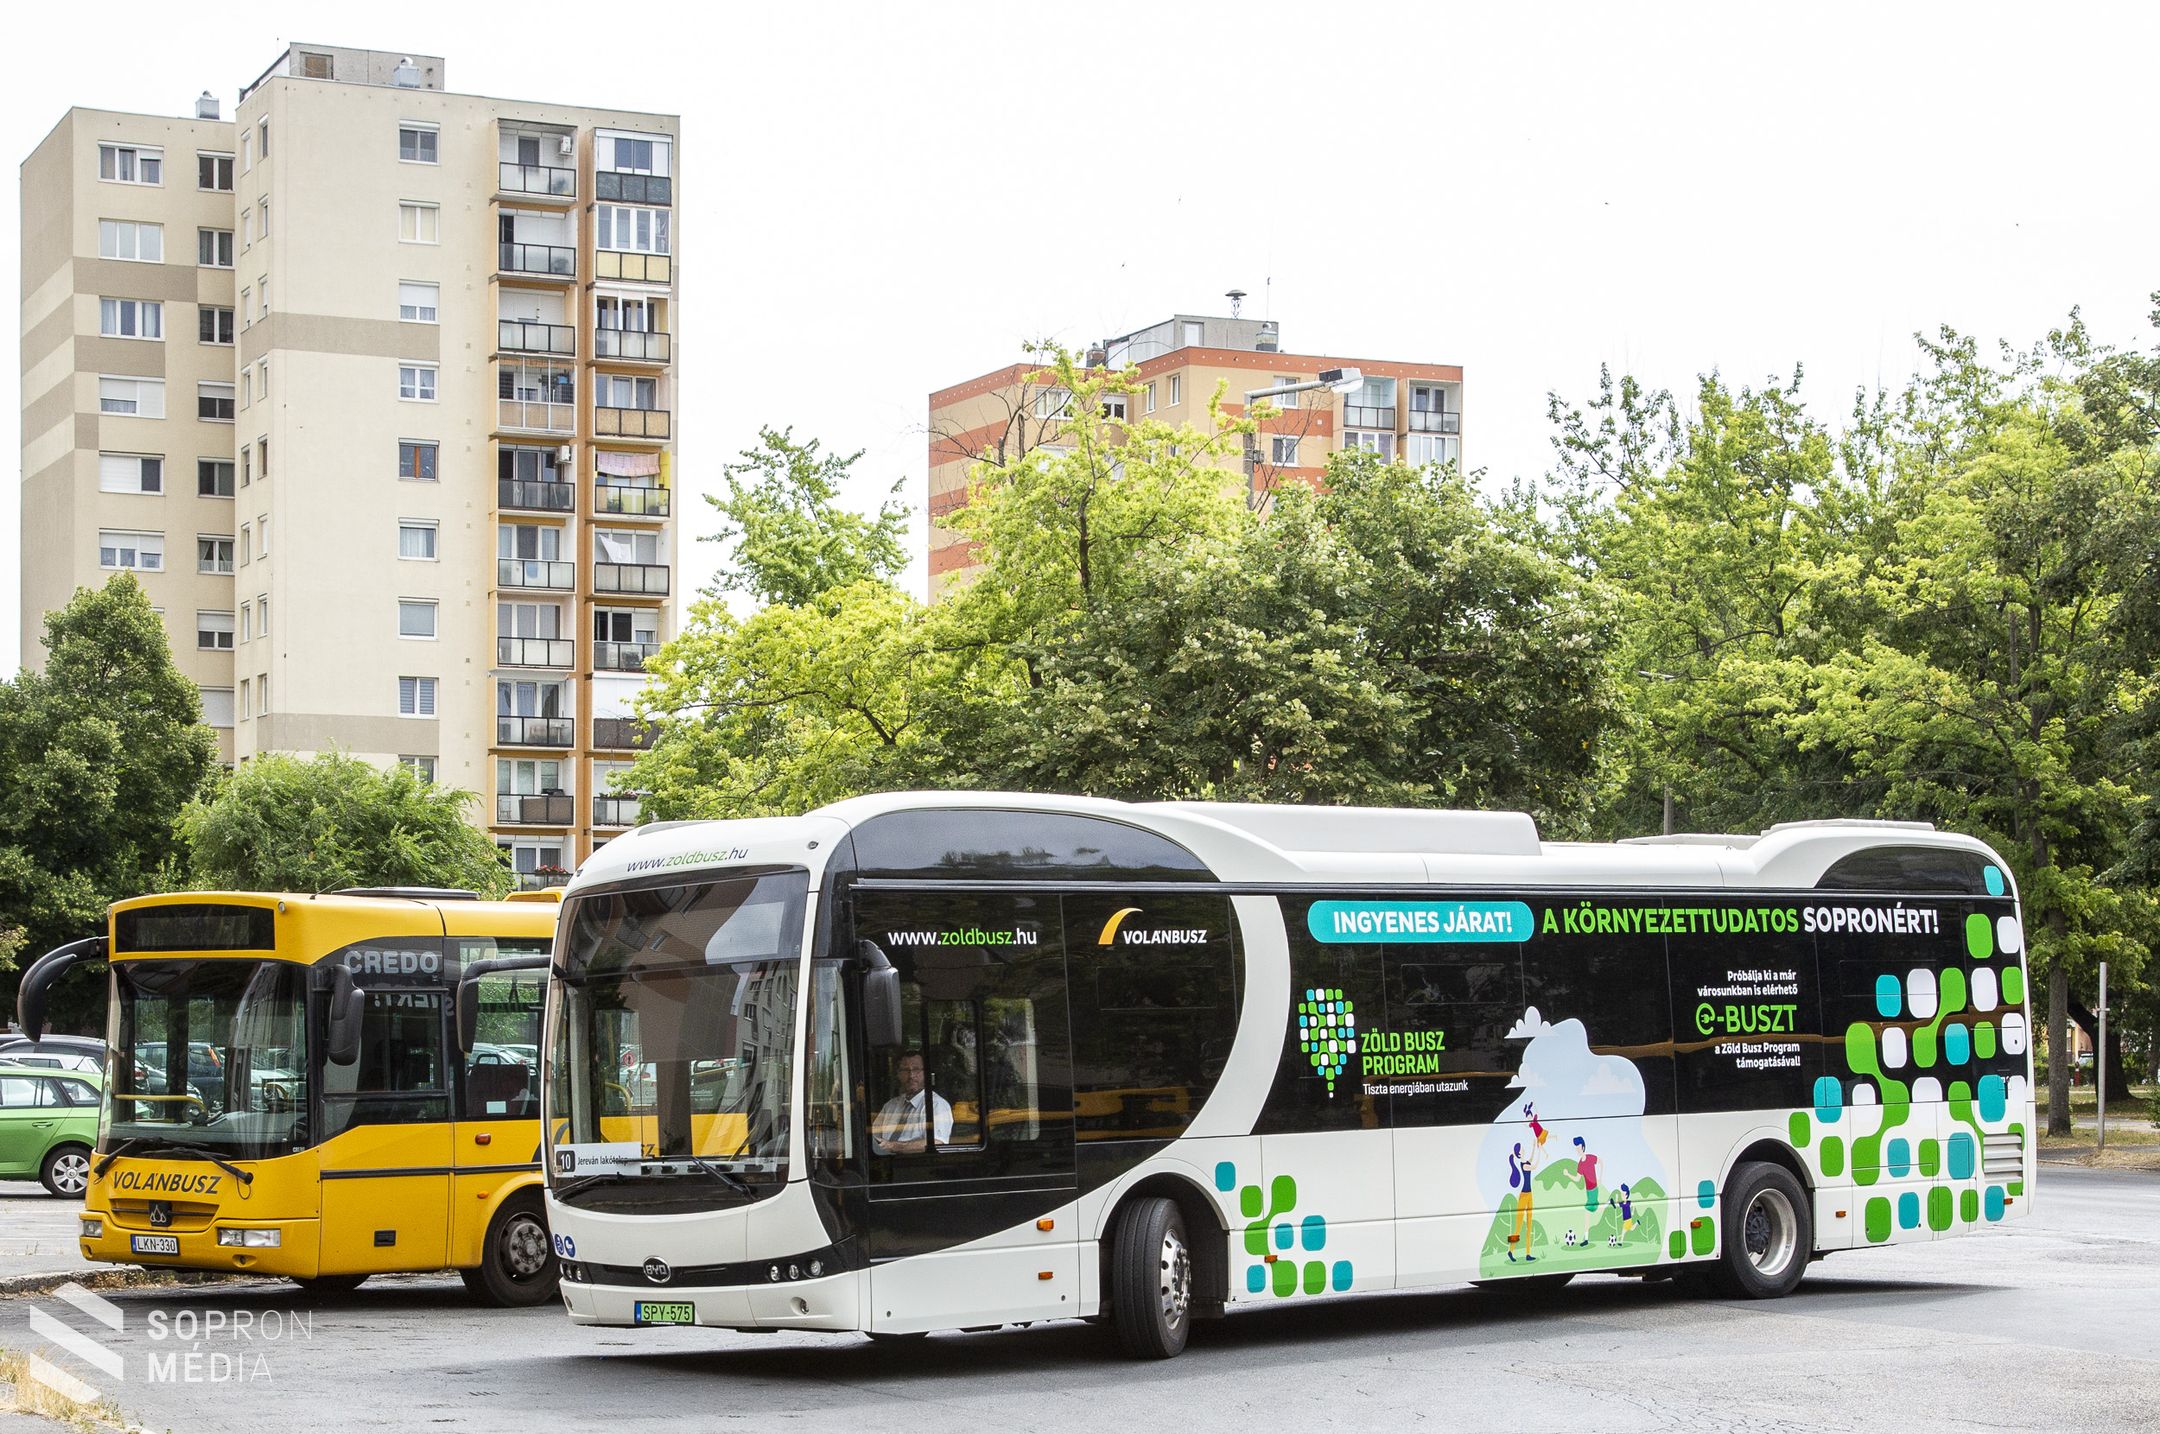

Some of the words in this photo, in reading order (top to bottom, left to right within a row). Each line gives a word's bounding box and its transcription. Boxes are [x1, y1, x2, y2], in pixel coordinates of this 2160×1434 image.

[627, 847, 748, 872] www.zoldbusz.hu
[1333, 911, 1440, 933] INGYENES
[1443, 905, 1513, 933] JÁRAT!
[1542, 908, 1559, 934] A
[1564, 901, 1798, 934] KÖRNYEZETTUDATOS
[1803, 901, 1940, 934] SOPRONÉRT!
[888, 927, 1037, 946] www.zoldbusz.hu
[1122, 929, 1207, 945] VOLÁNBUSZ
[343, 950, 439, 974] CREDO
[1727, 970, 1763, 983] Próbálja
[1763, 970, 1772, 981] ki
[1773, 972, 1779, 981] a
[1780, 969, 1797, 980] már
[1697, 985, 1753, 997] városunkban
[1754, 985, 1761, 996] is
[1762, 984, 1798, 996] elérhető
[1361, 1027, 1401, 1053] ZÖLD
[1404, 1031, 1446, 1052] BUSZ
[1714, 1045, 1720, 1055] a
[1721, 1043, 1741, 1054] Zöld
[1742, 1043, 1762, 1054] Busz
[1763, 1042, 1800, 1055] Program
[1363, 1053, 1440, 1076] PROGRAM
[1736, 1055, 1801, 1070] támogatásával!
[1363, 1083, 1389, 1096] Tiszta
[1389, 1081, 1435, 1097] energiában
[1437, 1079, 1469, 1092] utazunk
[560, 1153, 572, 1170] 10
[113, 1171, 222, 1195] VOLÁNBUSZ
[137, 1235, 177, 1252] LKN-330
[645, 1264, 668, 1275] BYD
[643, 1305, 691, 1321] SPY-575
